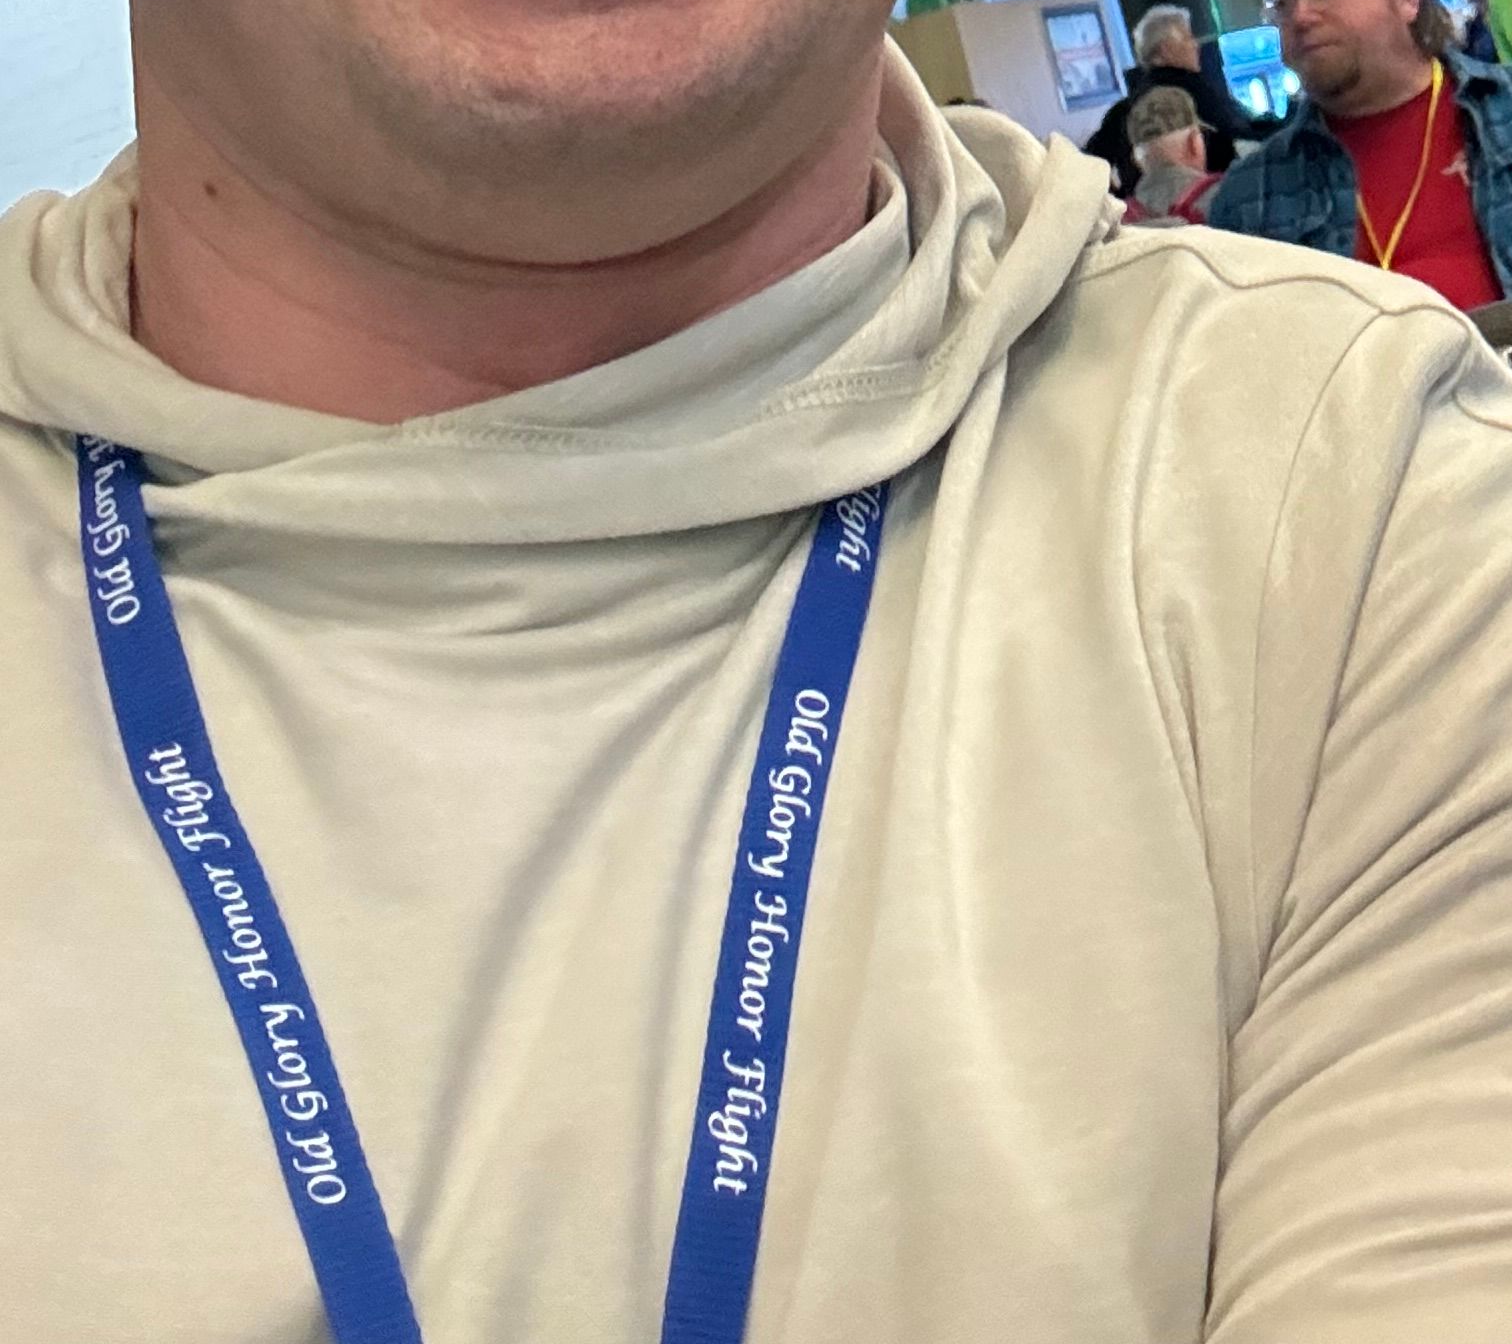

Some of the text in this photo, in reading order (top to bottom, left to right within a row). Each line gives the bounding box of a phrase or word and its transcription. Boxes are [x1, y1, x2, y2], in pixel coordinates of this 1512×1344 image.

[87, 459, 131, 557] Glory
[836, 486, 881, 572] light
[94, 556, 141, 626] Old
[145, 742, 347, 1205] Old Glory Honor Flight
[707, 689, 830, 1197] Old Glory Honor Flight
